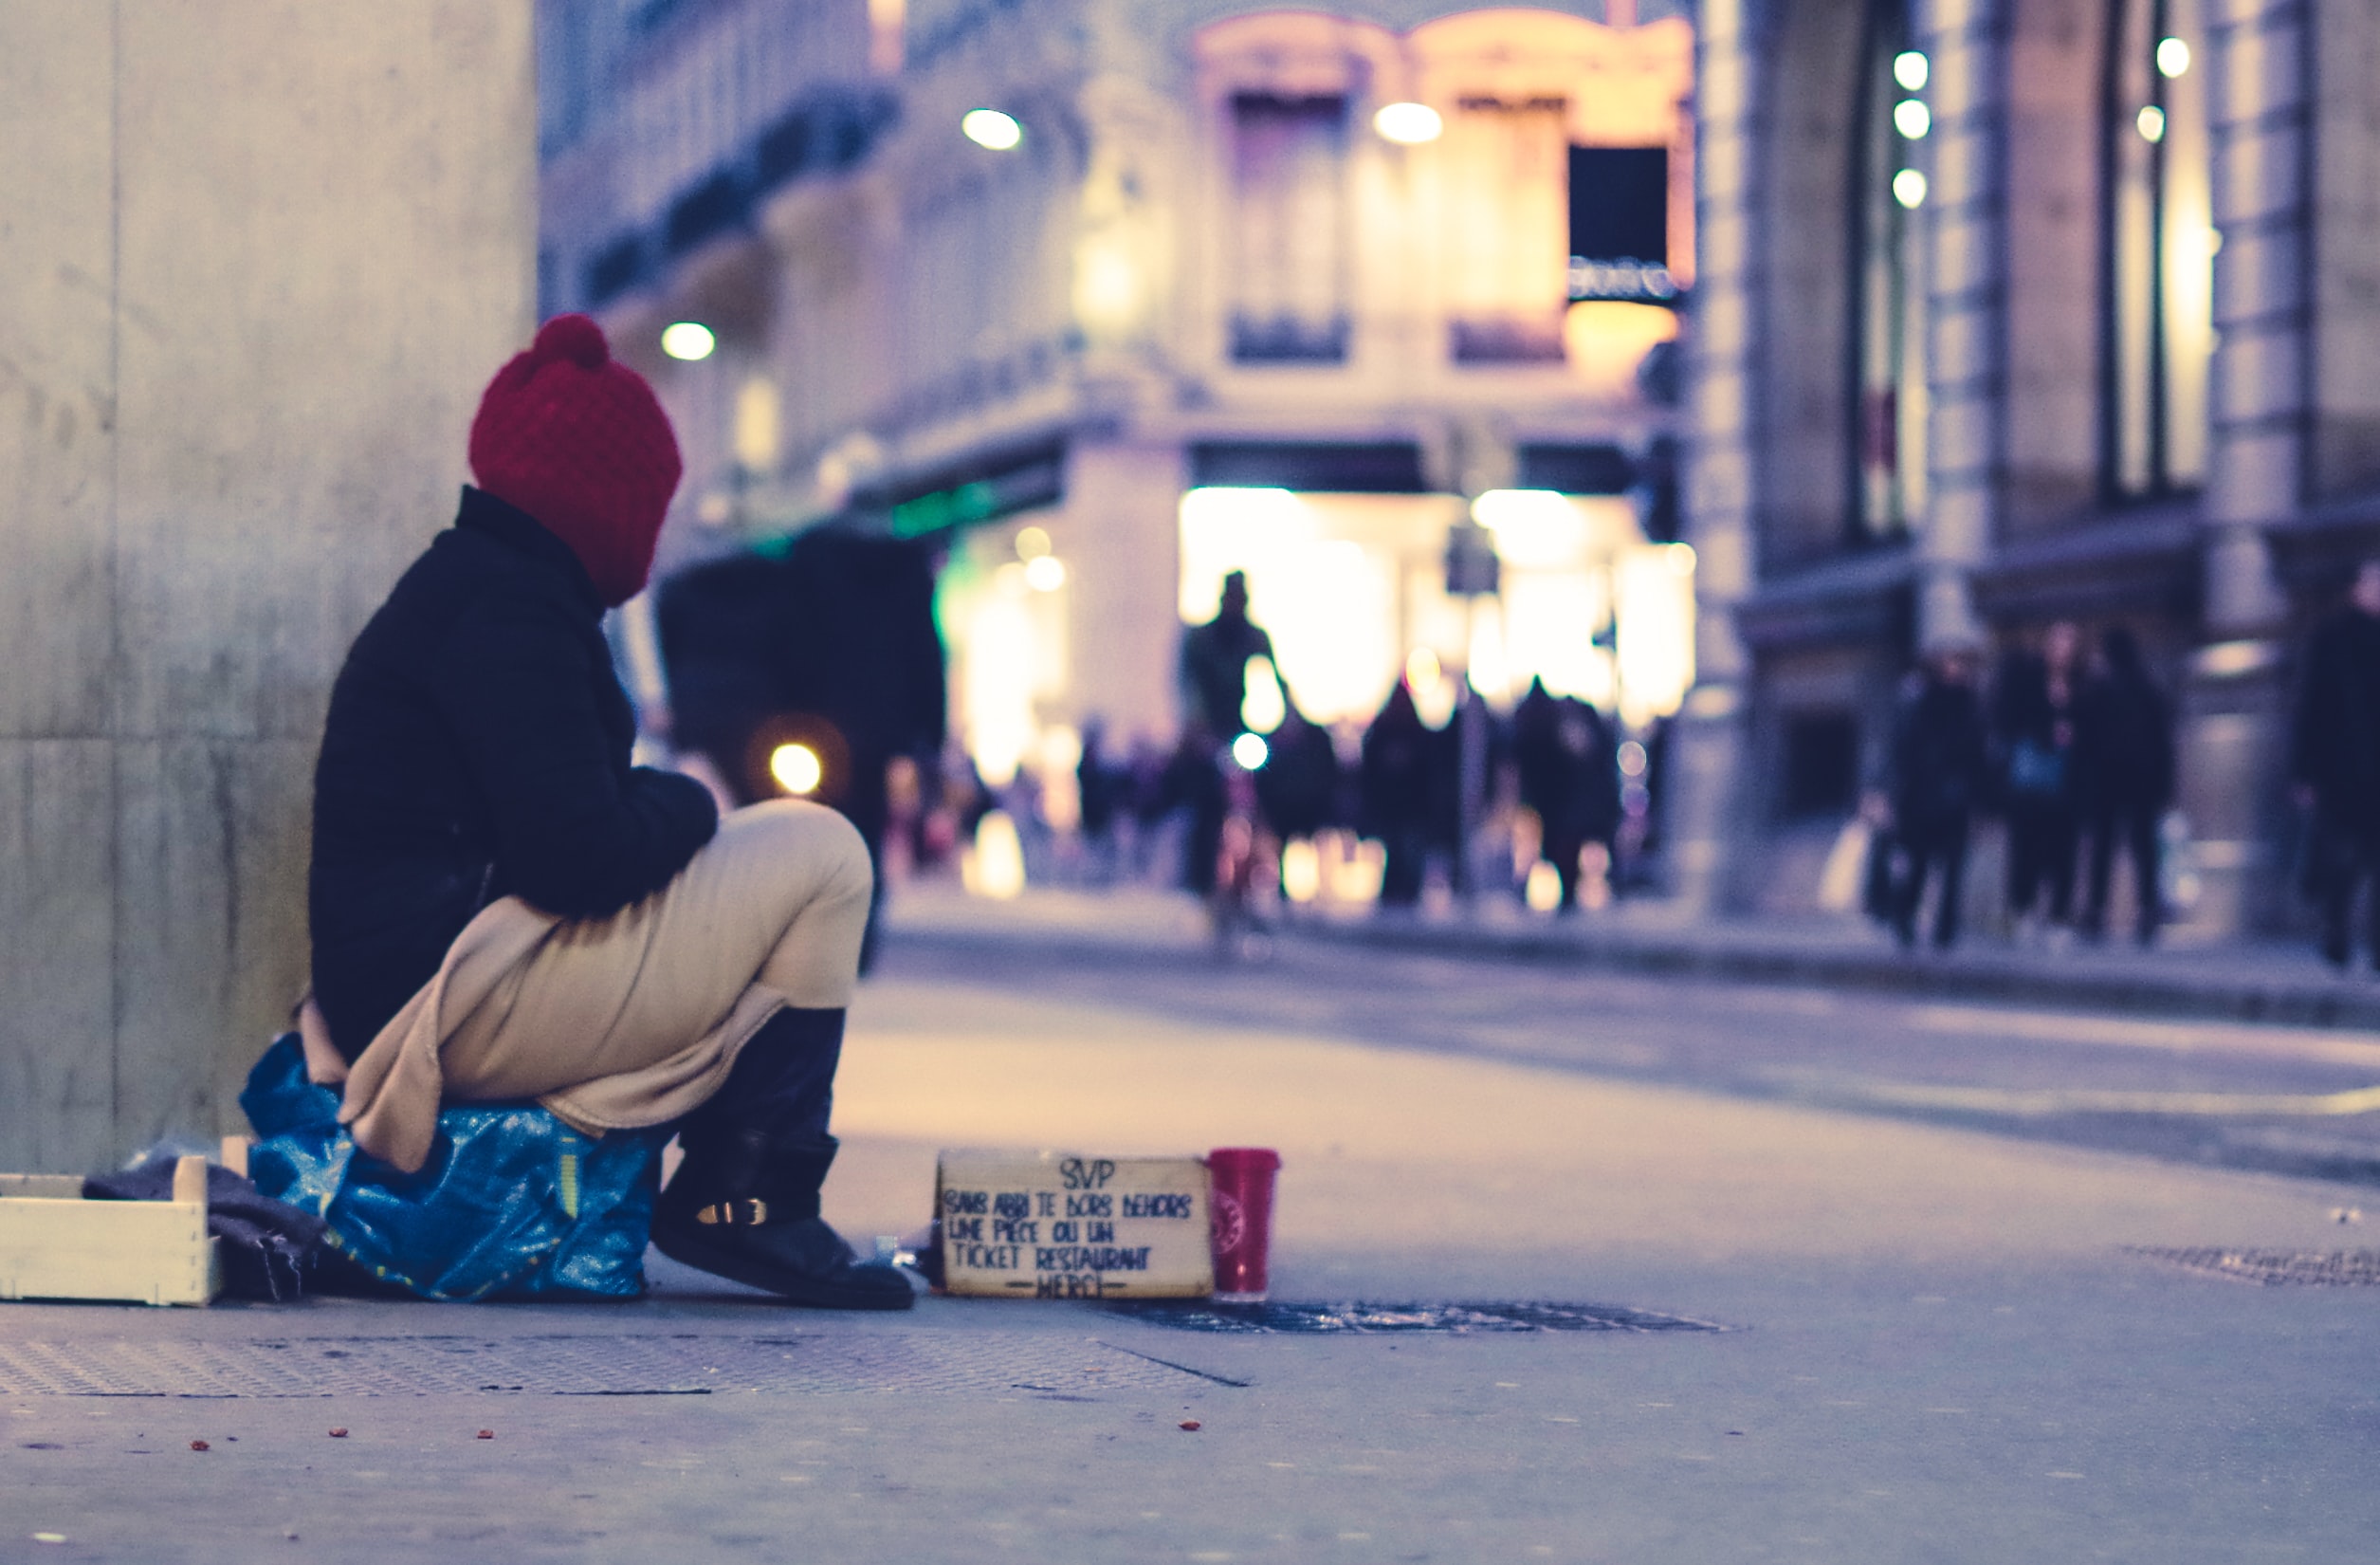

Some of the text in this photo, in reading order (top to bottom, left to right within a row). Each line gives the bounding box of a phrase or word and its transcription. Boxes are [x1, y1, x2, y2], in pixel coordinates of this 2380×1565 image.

[1060, 1158, 1115, 1189] SVP
[943, 1190, 988, 1214] SANS
[1067, 1193, 1113, 1218] DORS
[1123, 1192, 1193, 1219] DEHORS
[948, 1217, 982, 1242] UNE
[1053, 1221, 1078, 1243] OU
[1087, 1221, 1114, 1243] UN
[1035, 1247, 1152, 1270] RESTAURANT
